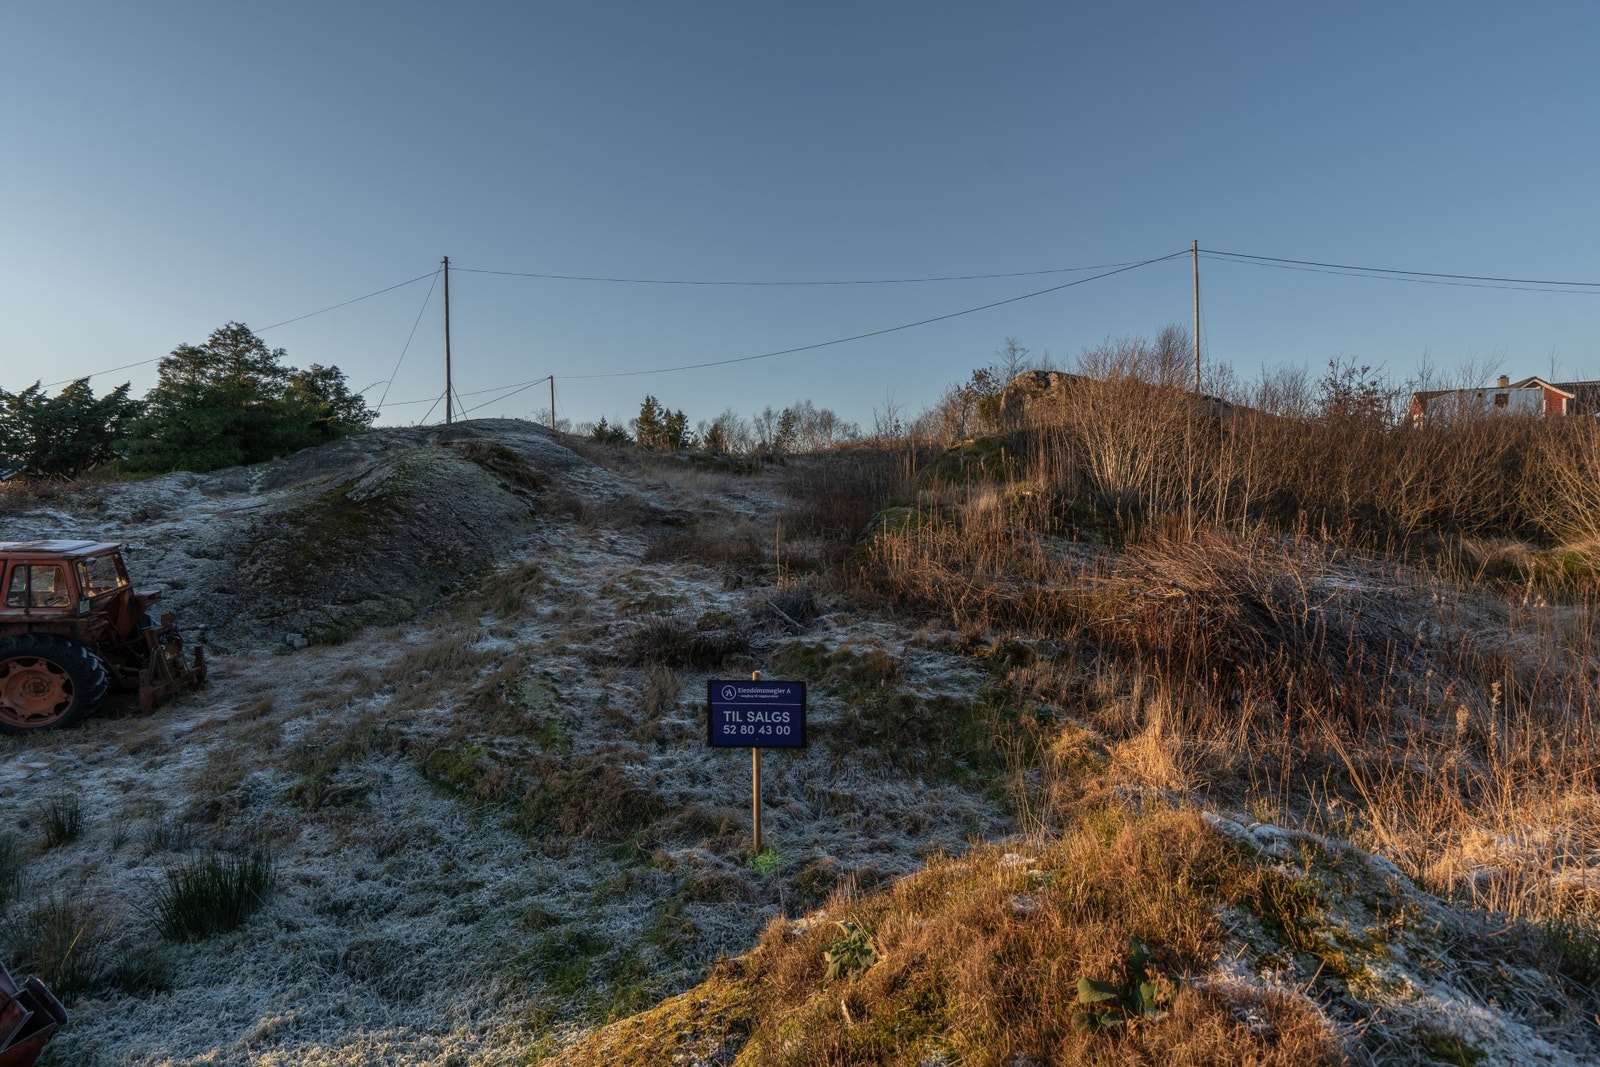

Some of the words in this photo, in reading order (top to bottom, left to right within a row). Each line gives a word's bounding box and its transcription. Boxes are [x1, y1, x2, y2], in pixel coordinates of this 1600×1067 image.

[723, 711, 743, 722] TIL
[747, 711, 790, 723] SALGS
[723, 725, 737, 734] 52
[740, 725, 755, 735] 80
[758, 725, 772, 735] 43
[776, 725, 791, 735] 00
